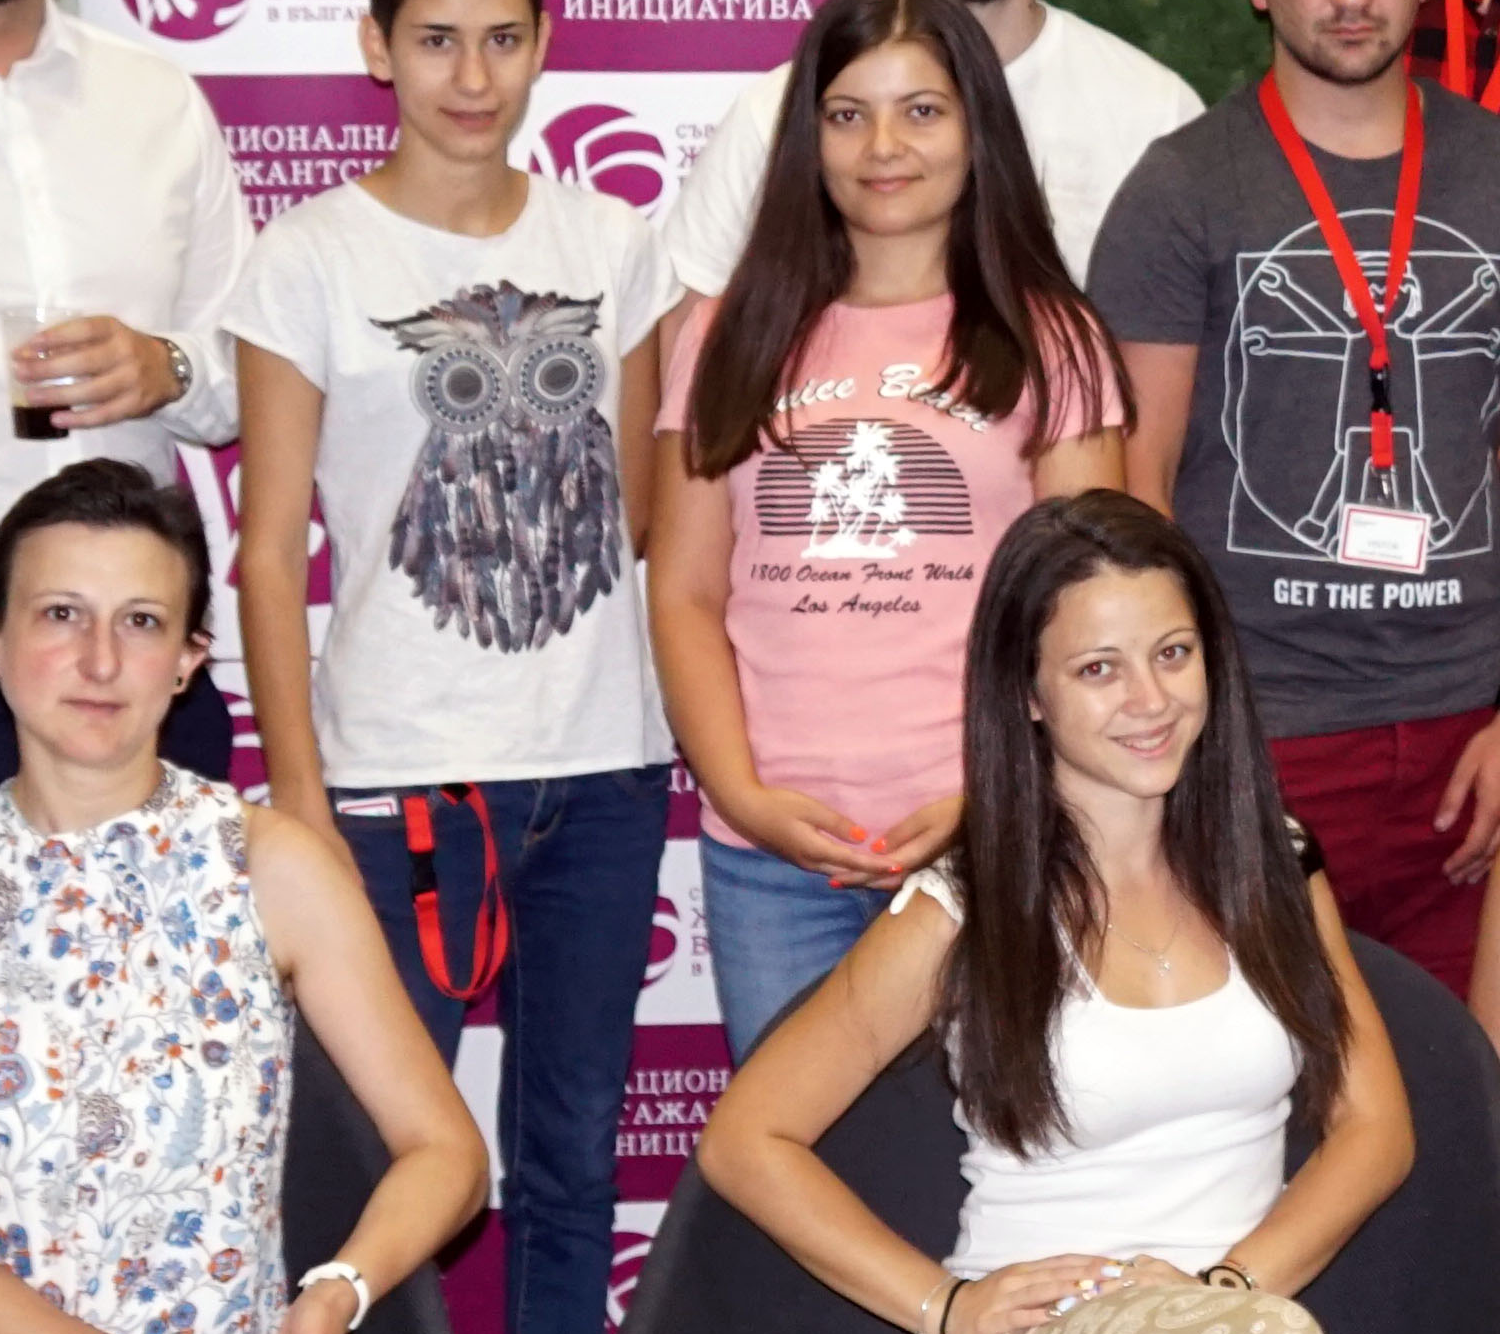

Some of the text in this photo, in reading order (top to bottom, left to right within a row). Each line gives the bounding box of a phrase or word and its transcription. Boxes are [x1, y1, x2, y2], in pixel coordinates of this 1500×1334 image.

[267, 7, 279, 22] В
[750, 562, 975, 584] 1800 Ocean Front Walk
[1273, 577, 1463, 609] GET THE POWER
[790, 593, 922, 617] Los Angeles
